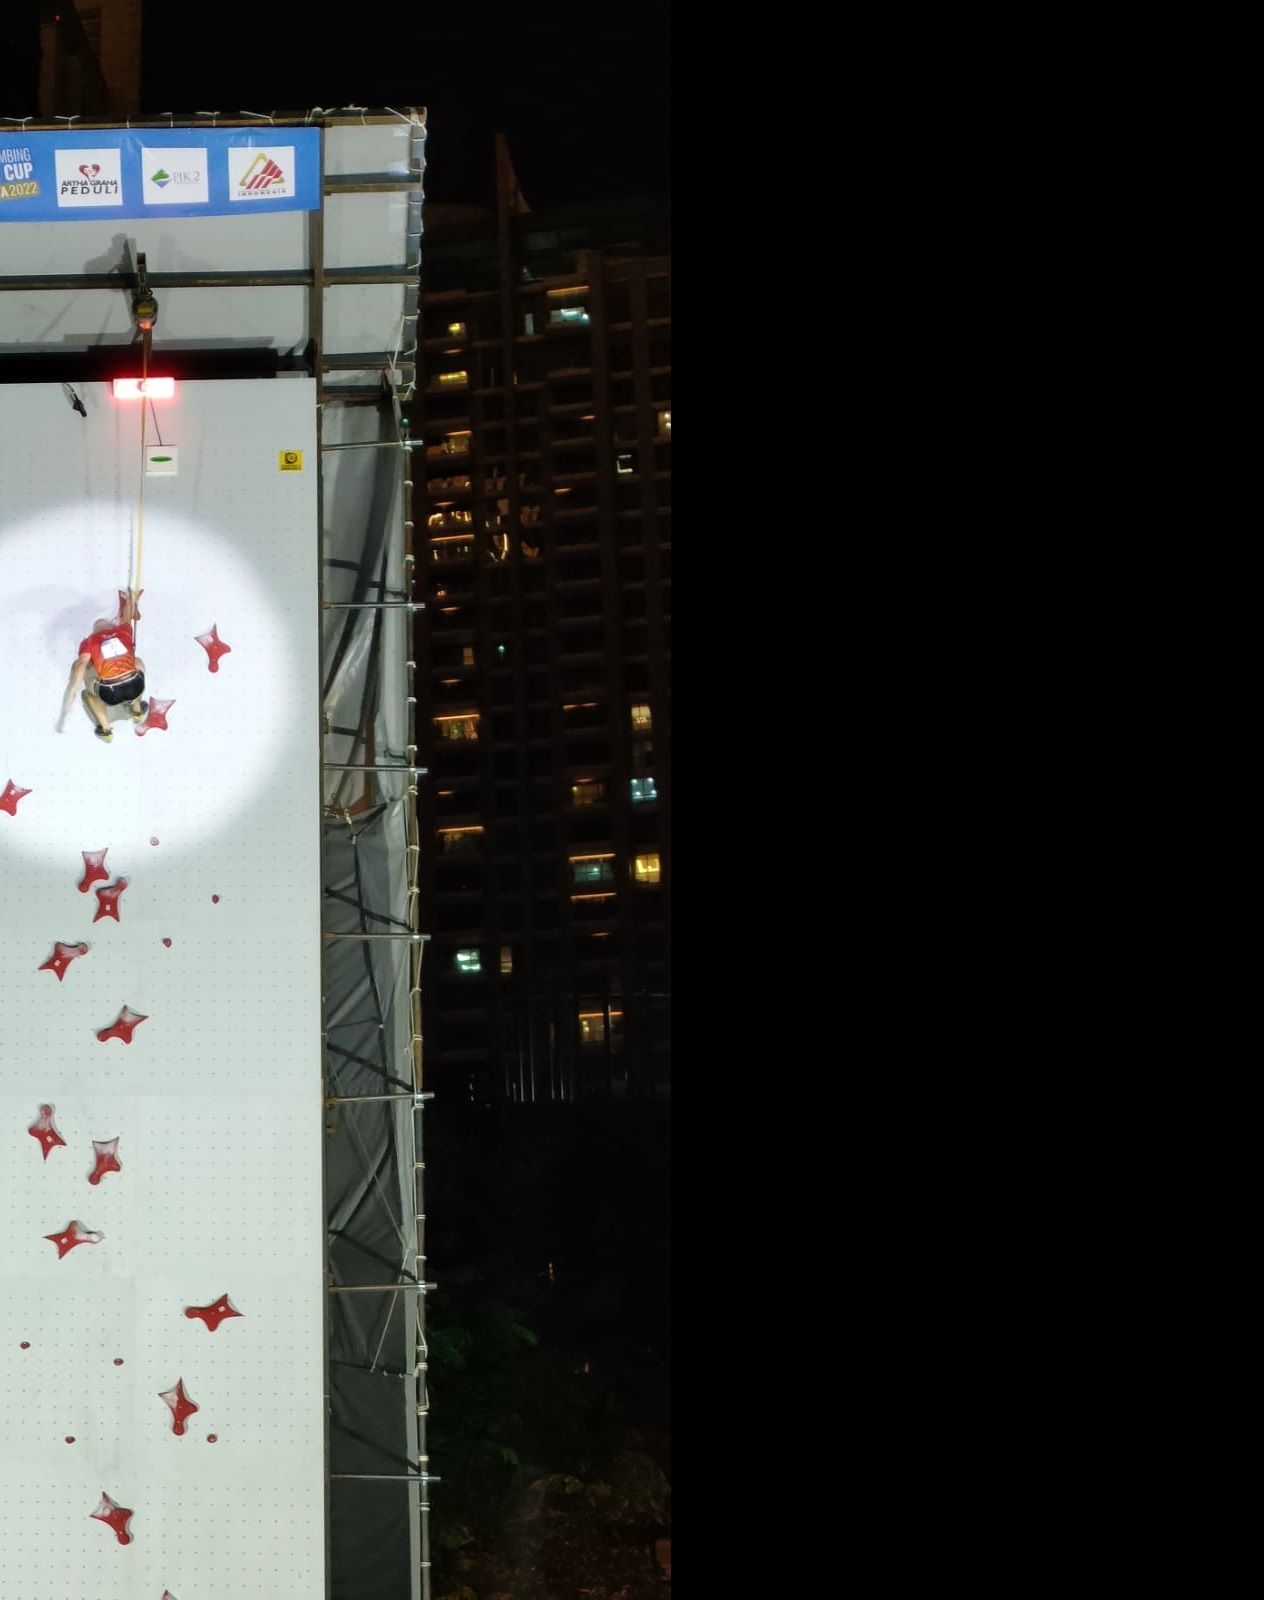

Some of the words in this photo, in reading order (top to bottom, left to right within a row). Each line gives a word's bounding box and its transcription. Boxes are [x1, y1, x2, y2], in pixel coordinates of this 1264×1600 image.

[3, 162, 34, 181] CUP
[9, 182, 38, 197] 2022
[60, 186, 118, 195] PEDULI
